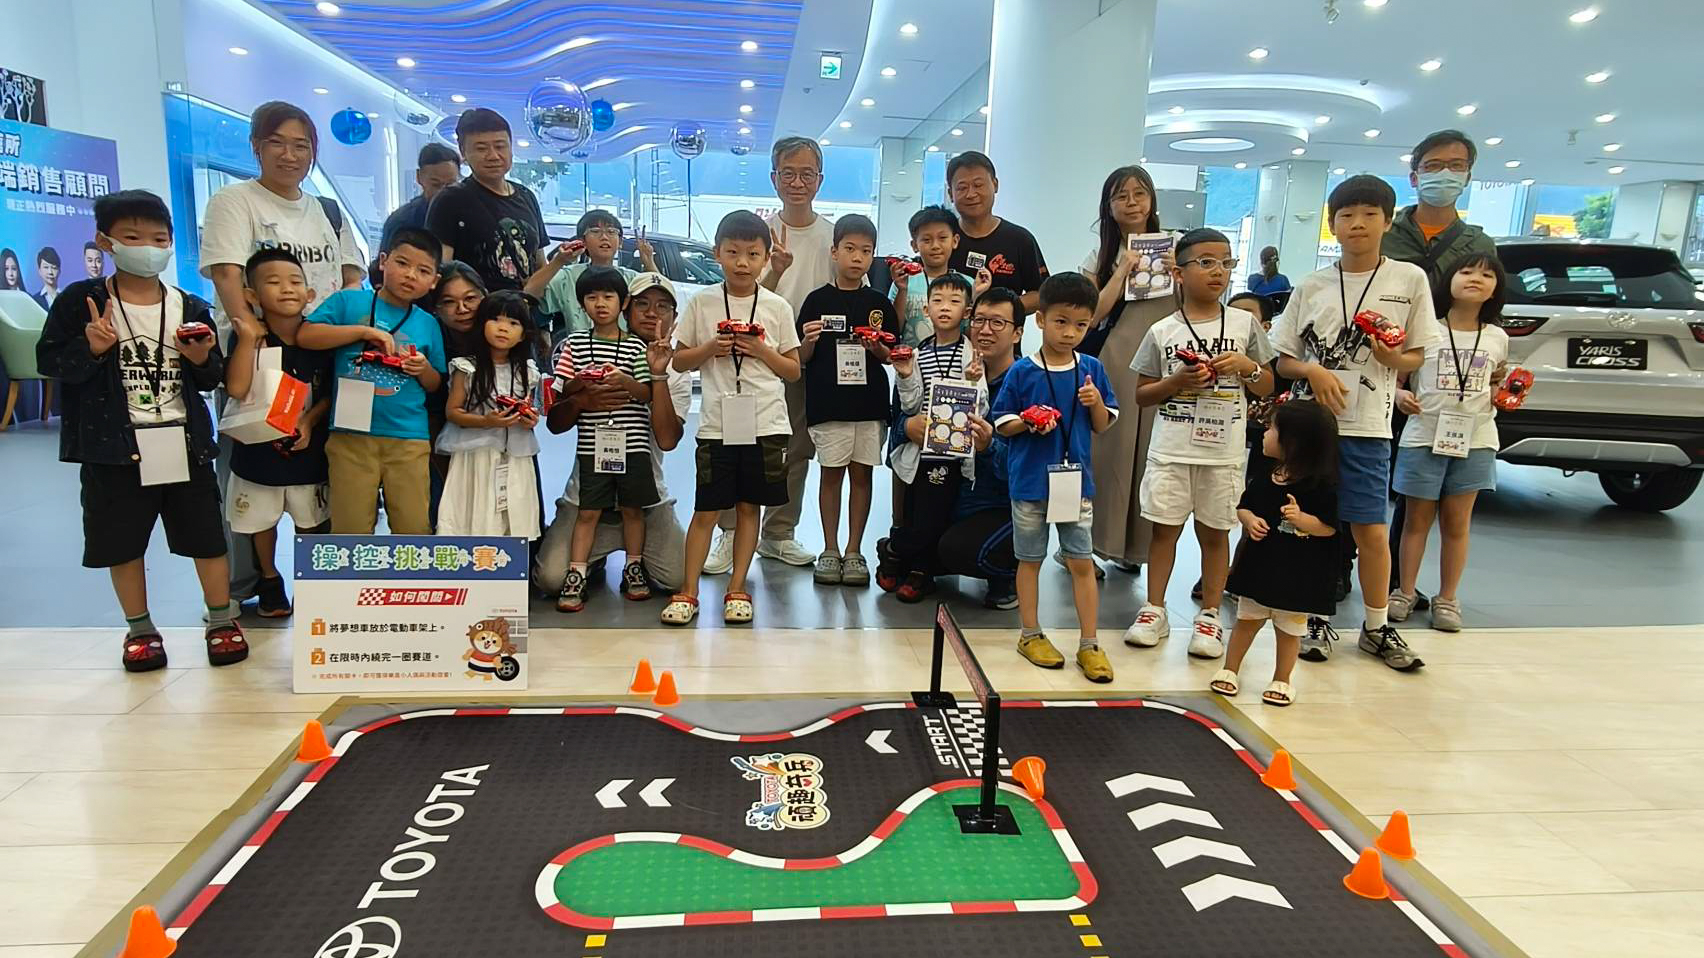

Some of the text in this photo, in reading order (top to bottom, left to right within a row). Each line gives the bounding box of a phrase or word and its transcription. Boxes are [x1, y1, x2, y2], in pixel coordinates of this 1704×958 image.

[0, 132, 20, 157] 所
[1579, 345, 1623, 356] YARIS
[312, 544, 498, 571] 操控挑戰賽
[922, 715, 960, 769] START
[356, 764, 490, 909] TOYOTA
